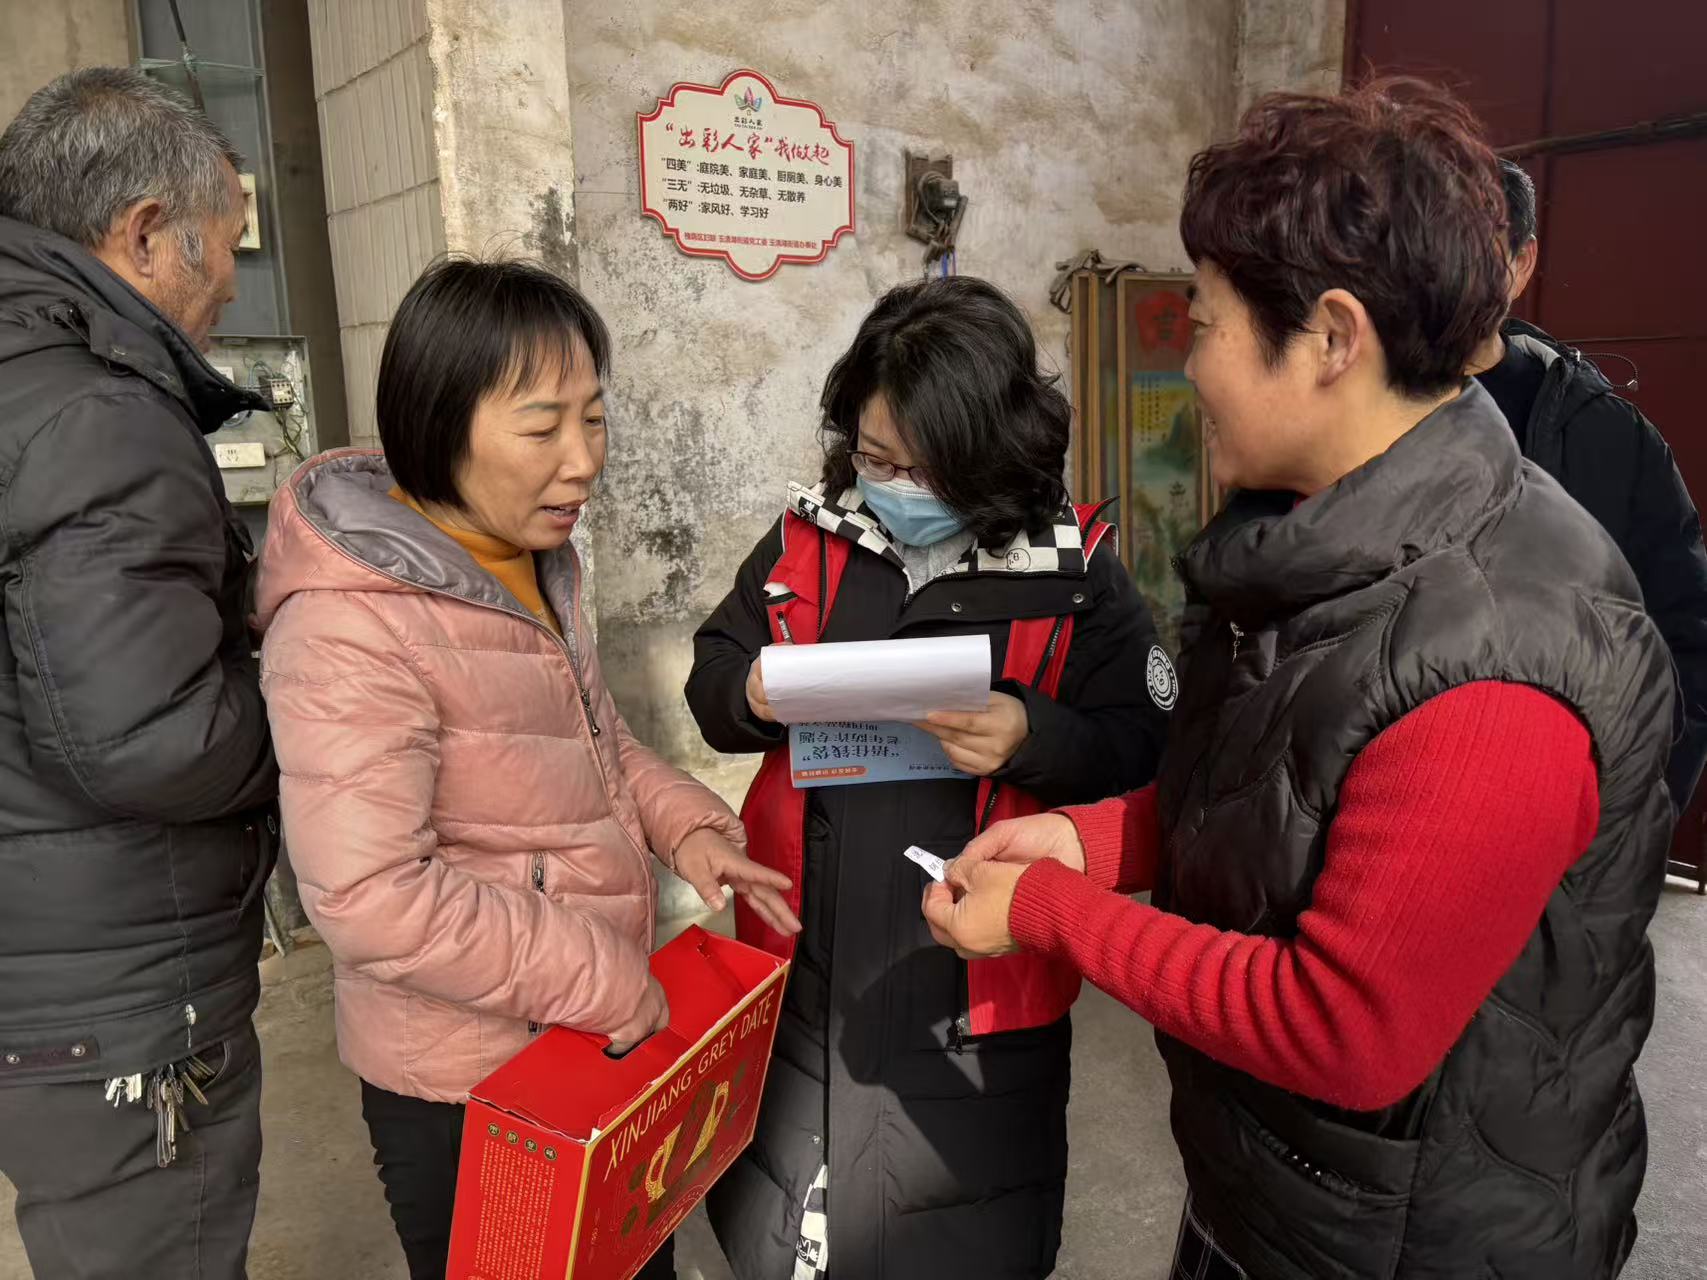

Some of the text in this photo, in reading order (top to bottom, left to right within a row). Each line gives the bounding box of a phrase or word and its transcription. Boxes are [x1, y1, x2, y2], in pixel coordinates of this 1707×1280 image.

[603, 1068, 692, 1182] XINJIANG
[698, 1023, 739, 1074] GREY
[740, 989, 774, 1039] DATE
